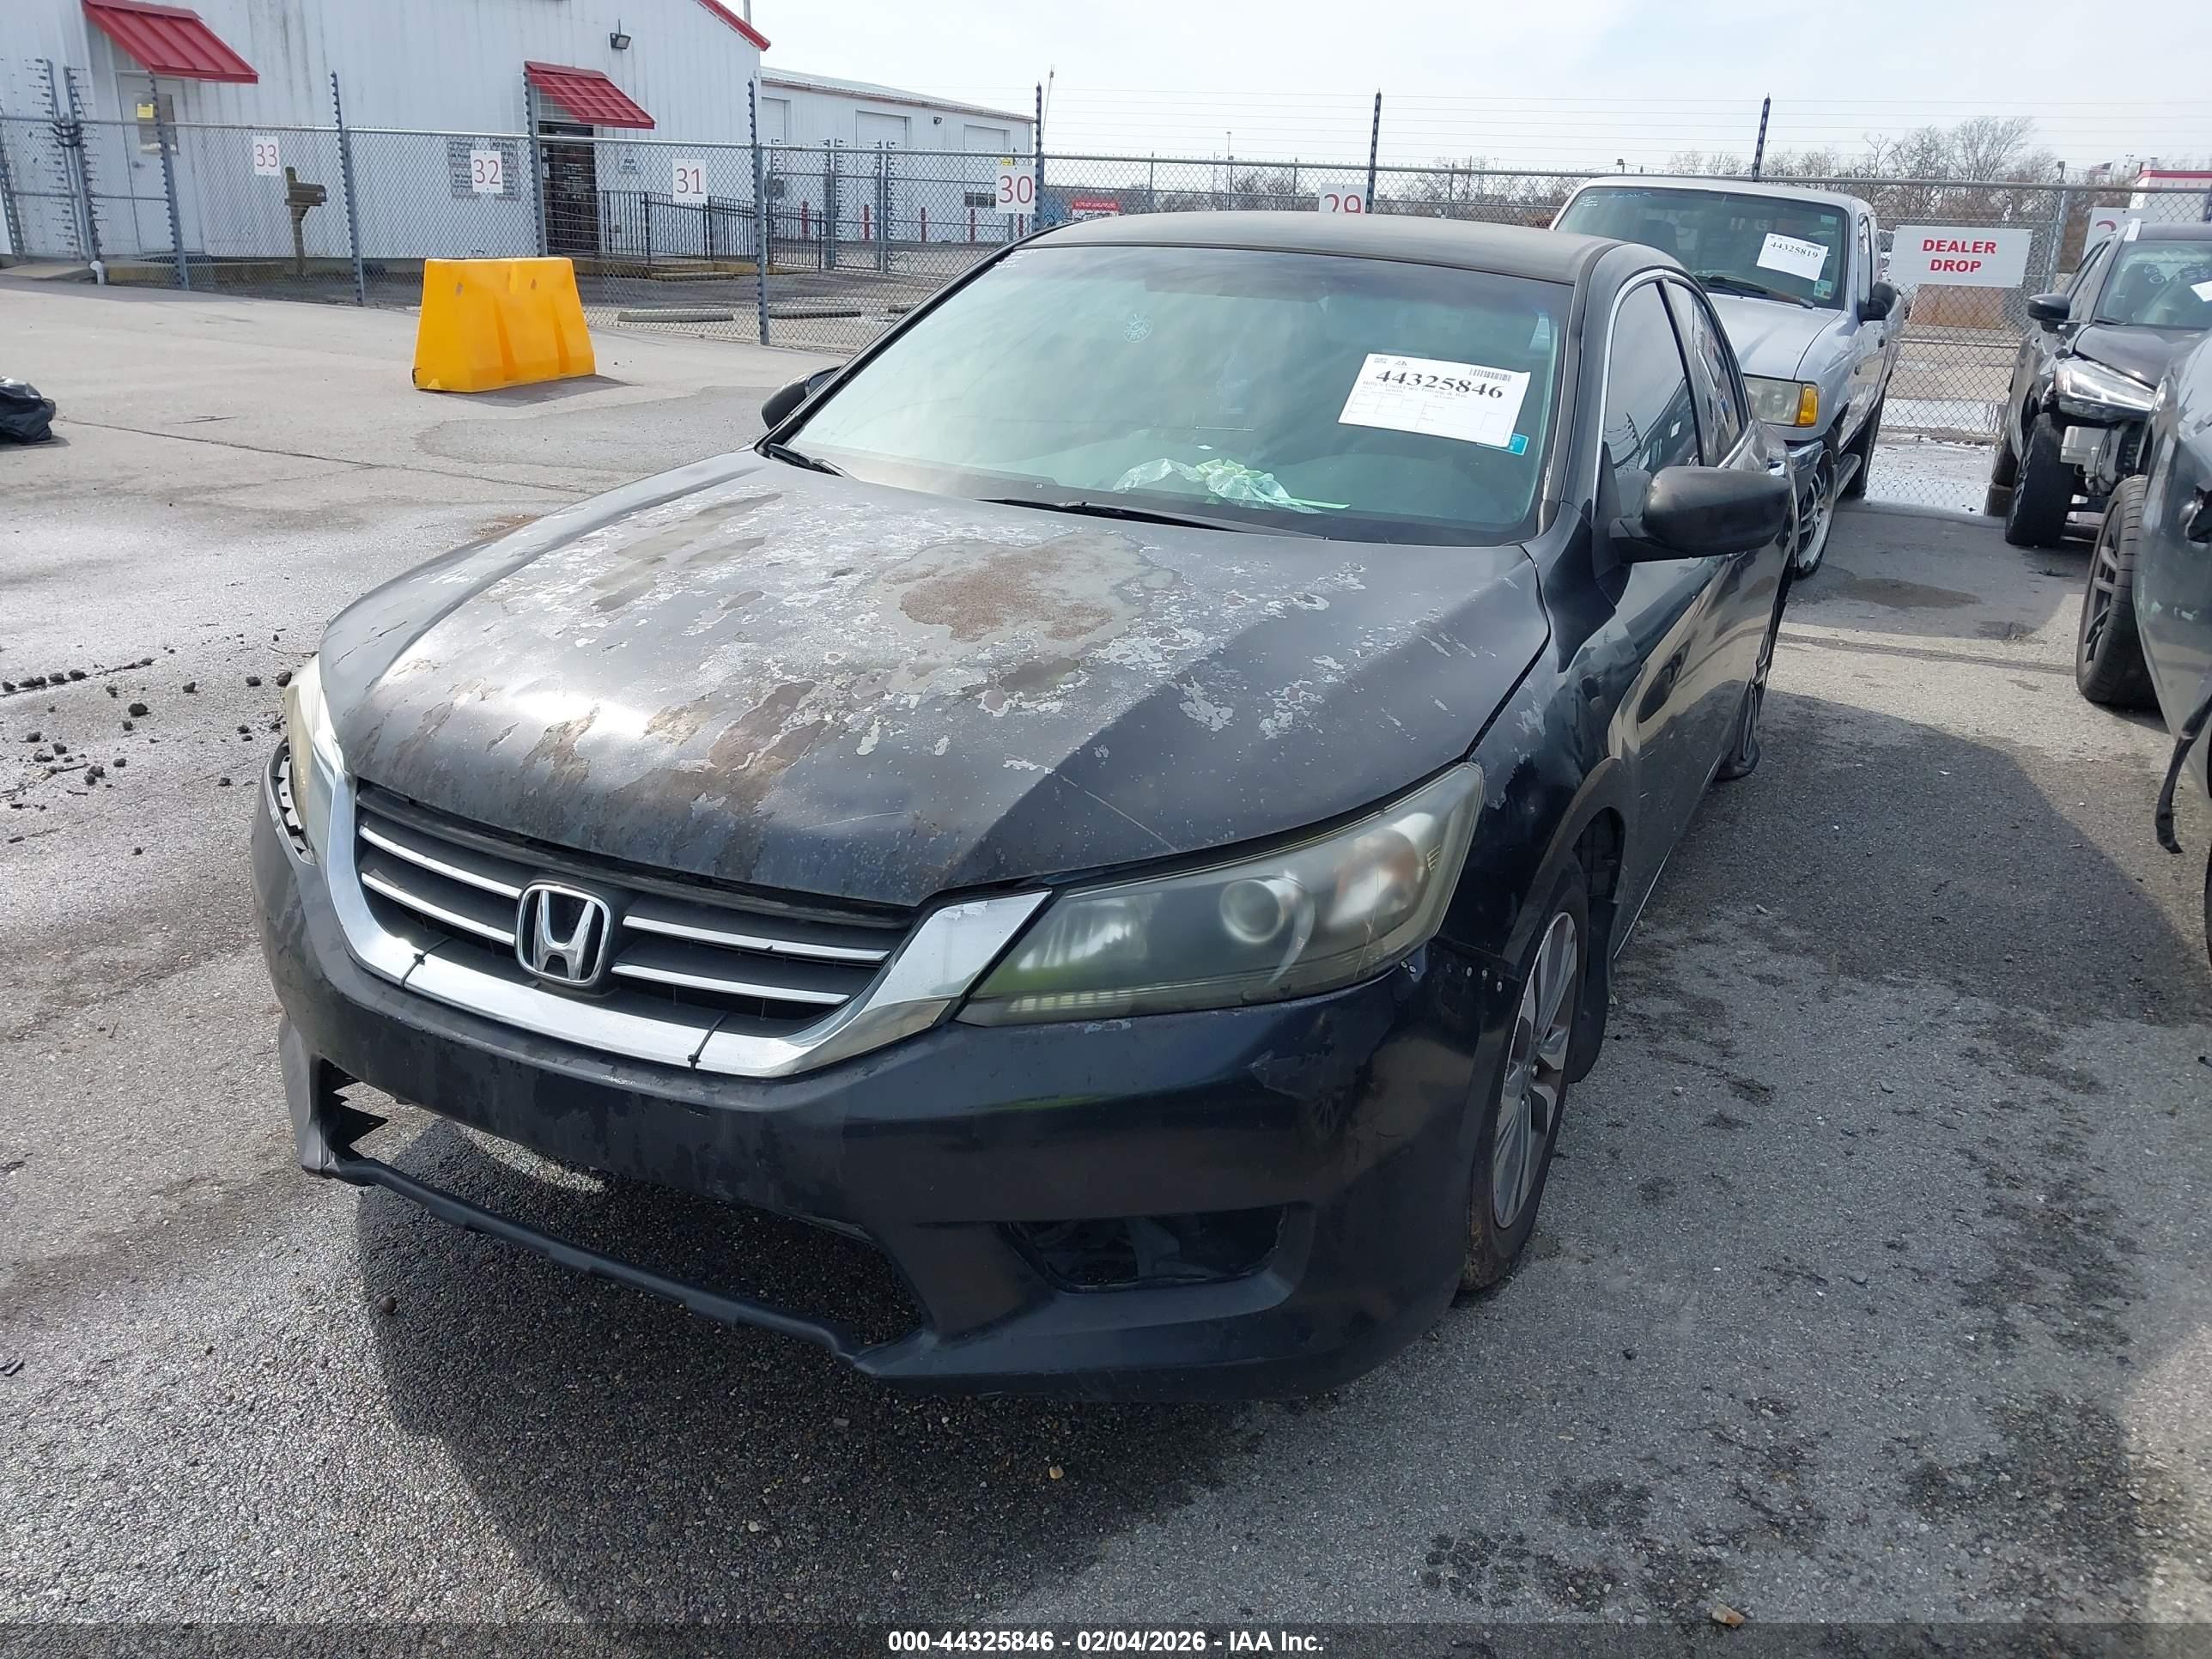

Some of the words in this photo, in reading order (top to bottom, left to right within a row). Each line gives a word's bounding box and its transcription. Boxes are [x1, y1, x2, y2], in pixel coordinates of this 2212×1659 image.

[255, 144, 278, 167] 33
[473, 159, 501, 185] 32
[676, 168, 704, 194] 31
[999, 175, 1035, 204] 30
[1770, 241, 1819, 258] 44325819
[1922, 239, 1997, 254] DEALER
[1929, 258, 1982, 273] DROP
[1376, 369, 1505, 399] 44325846
